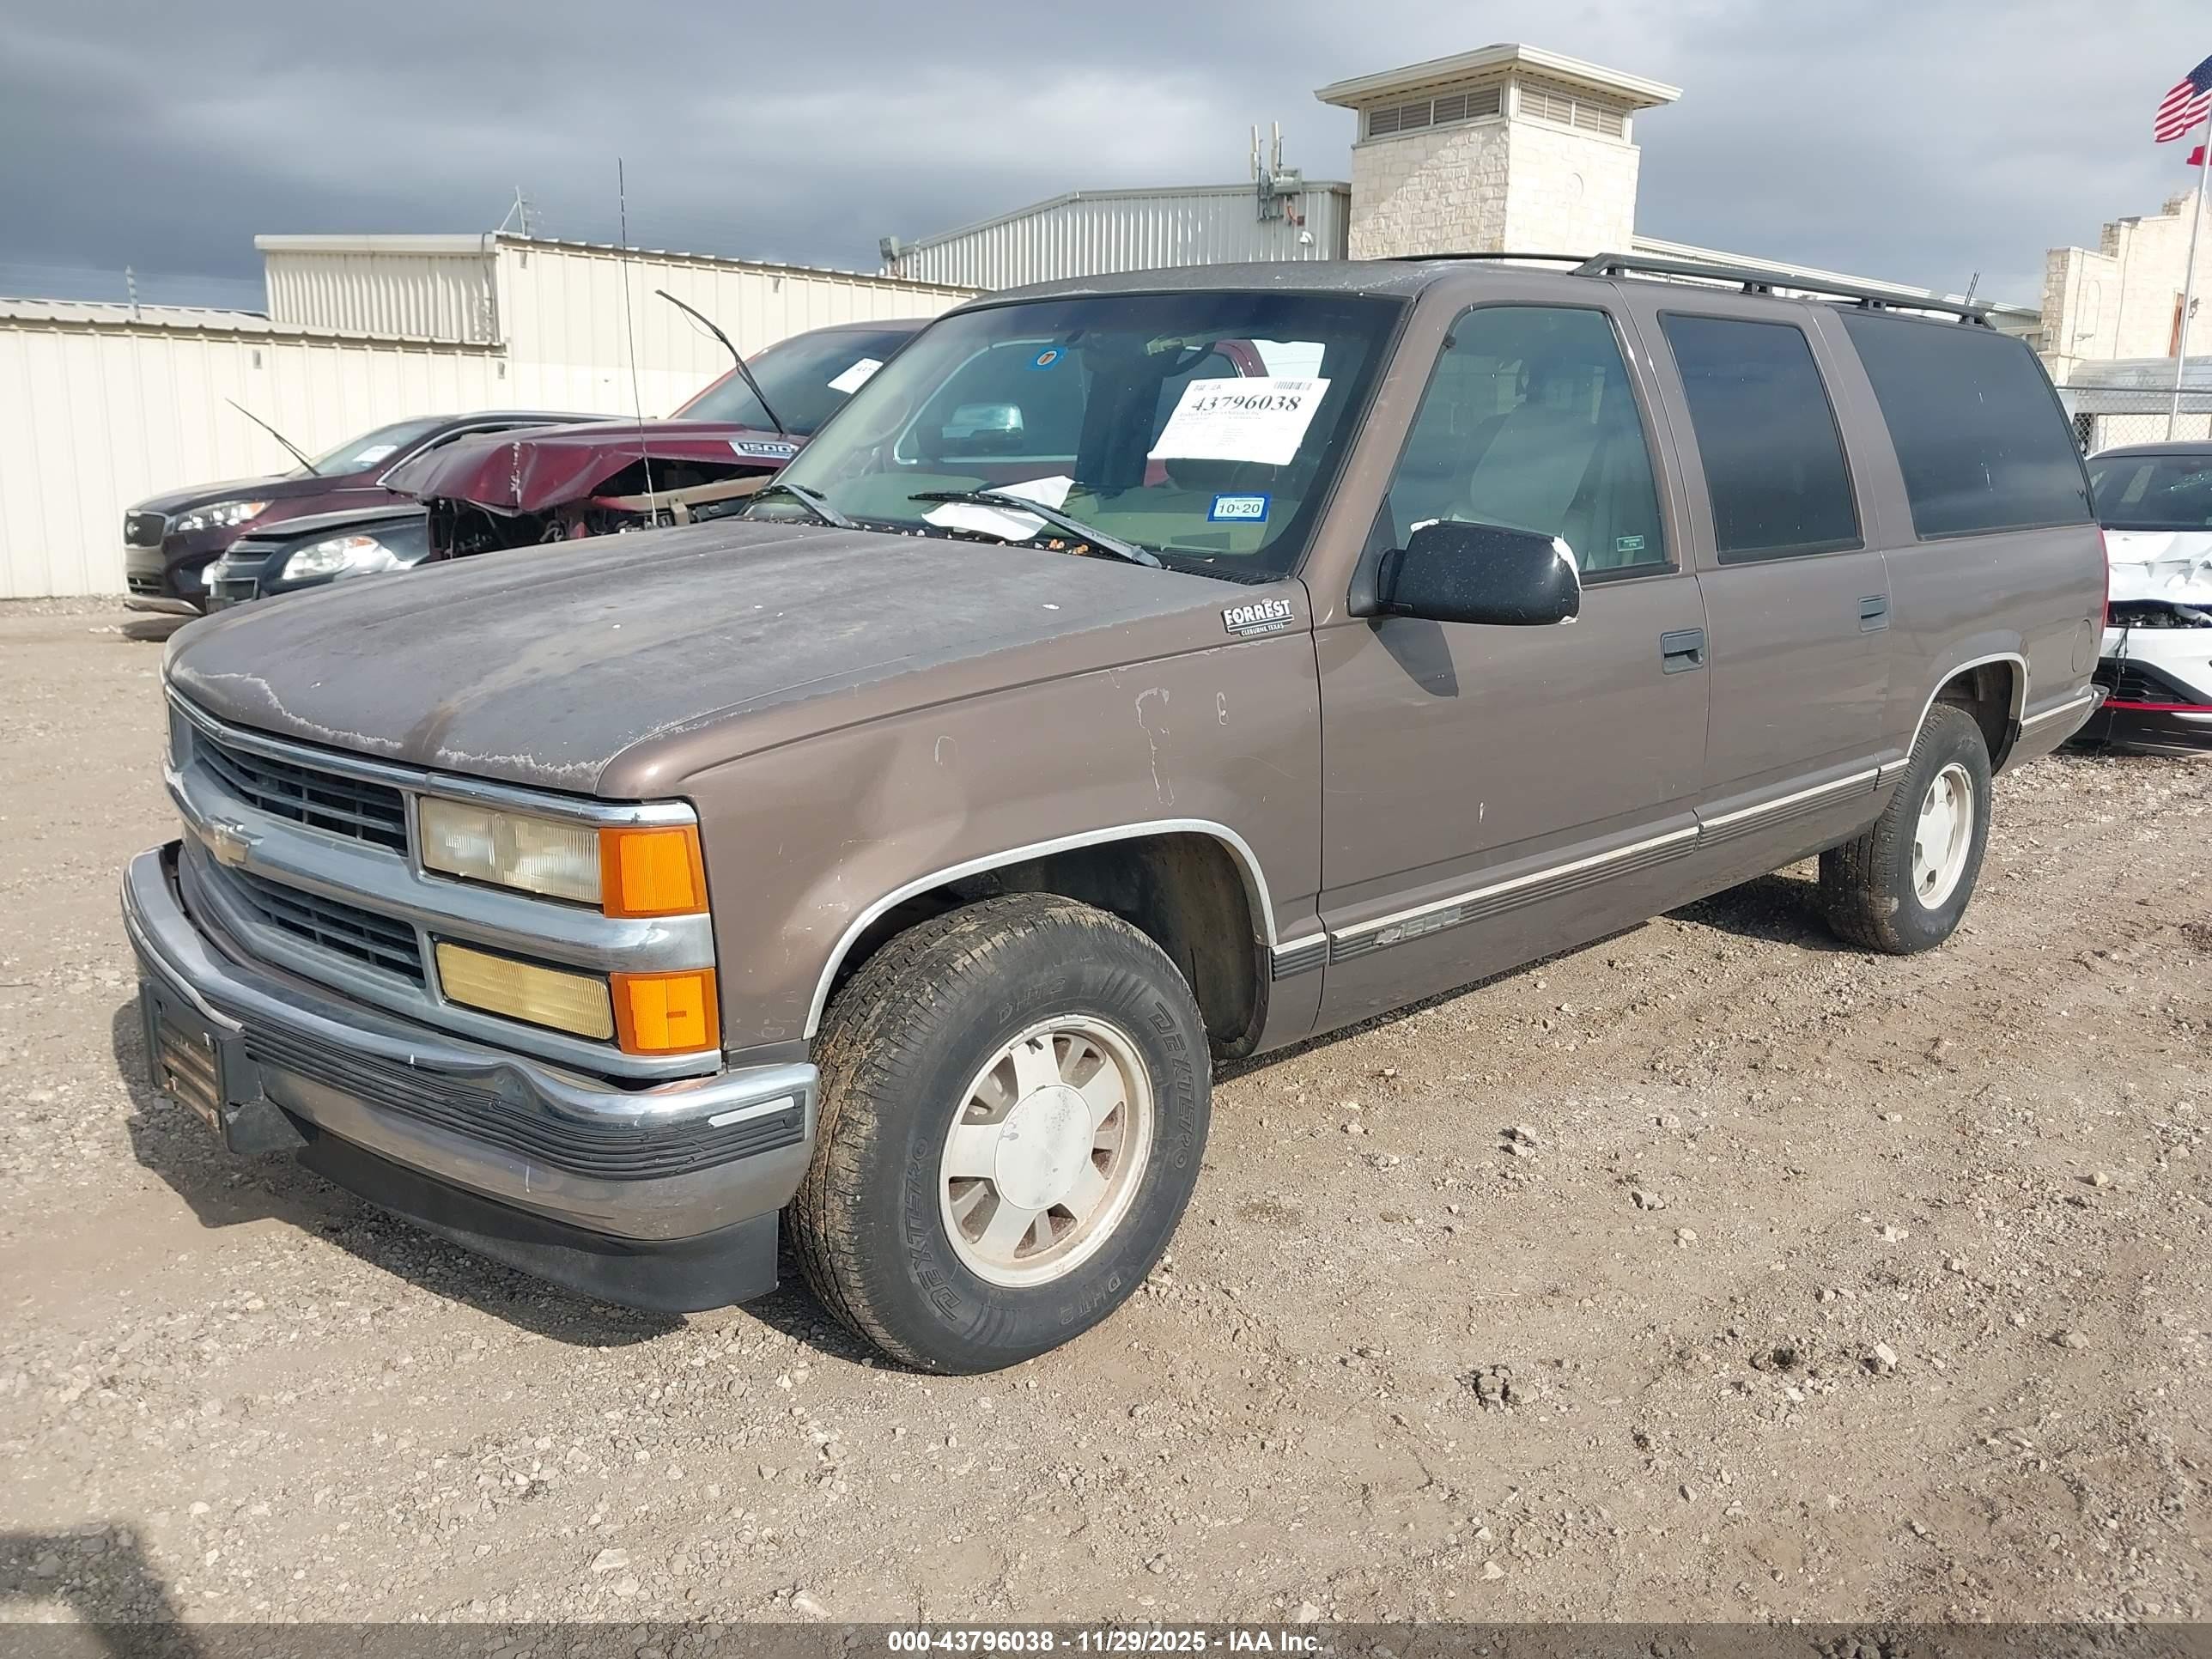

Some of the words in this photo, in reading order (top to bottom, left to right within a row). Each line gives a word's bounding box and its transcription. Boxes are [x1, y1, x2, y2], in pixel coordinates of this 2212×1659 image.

[1191, 394, 1302, 411] 43796038
[739, 442, 792, 453] 1500
[1219, 503, 1236, 514] 10
[1243, 503, 1261, 514] 20
[1223, 599, 1291, 625] FORREST
[1241, 625, 1268, 636] CLEBURNE
[1267, 623, 1285, 632] TEXAS
